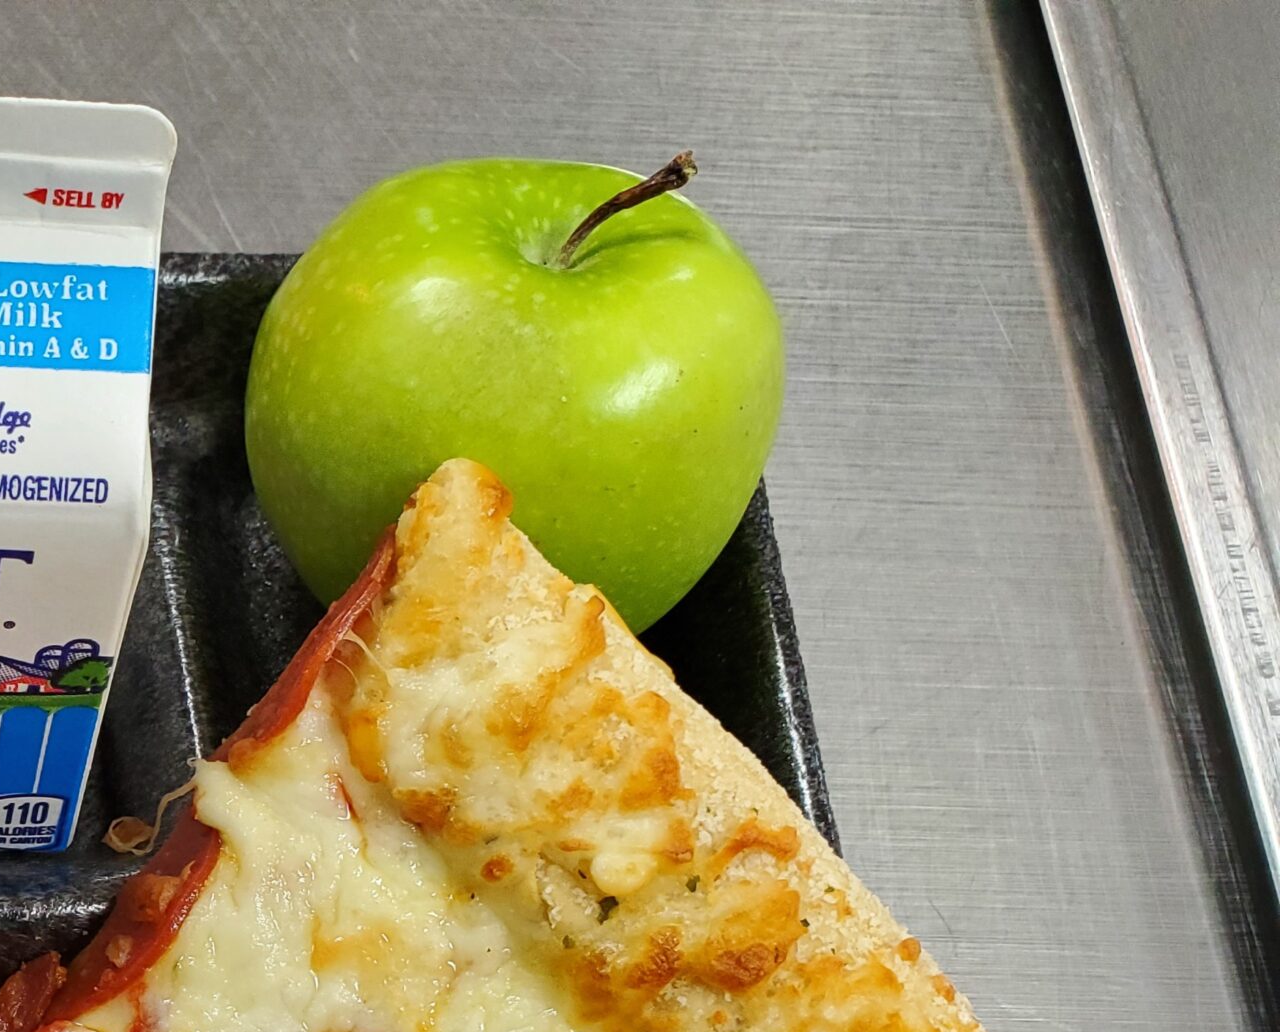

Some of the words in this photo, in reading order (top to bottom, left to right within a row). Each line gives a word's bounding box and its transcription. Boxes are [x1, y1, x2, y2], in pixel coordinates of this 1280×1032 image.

[52, 189, 96, 208] SELL
[101, 192, 125, 209] BY
[43, 336, 62, 359] A
[70, 337, 90, 360] &
[99, 338, 118, 361] D
[2, 801, 50, 825] 110
